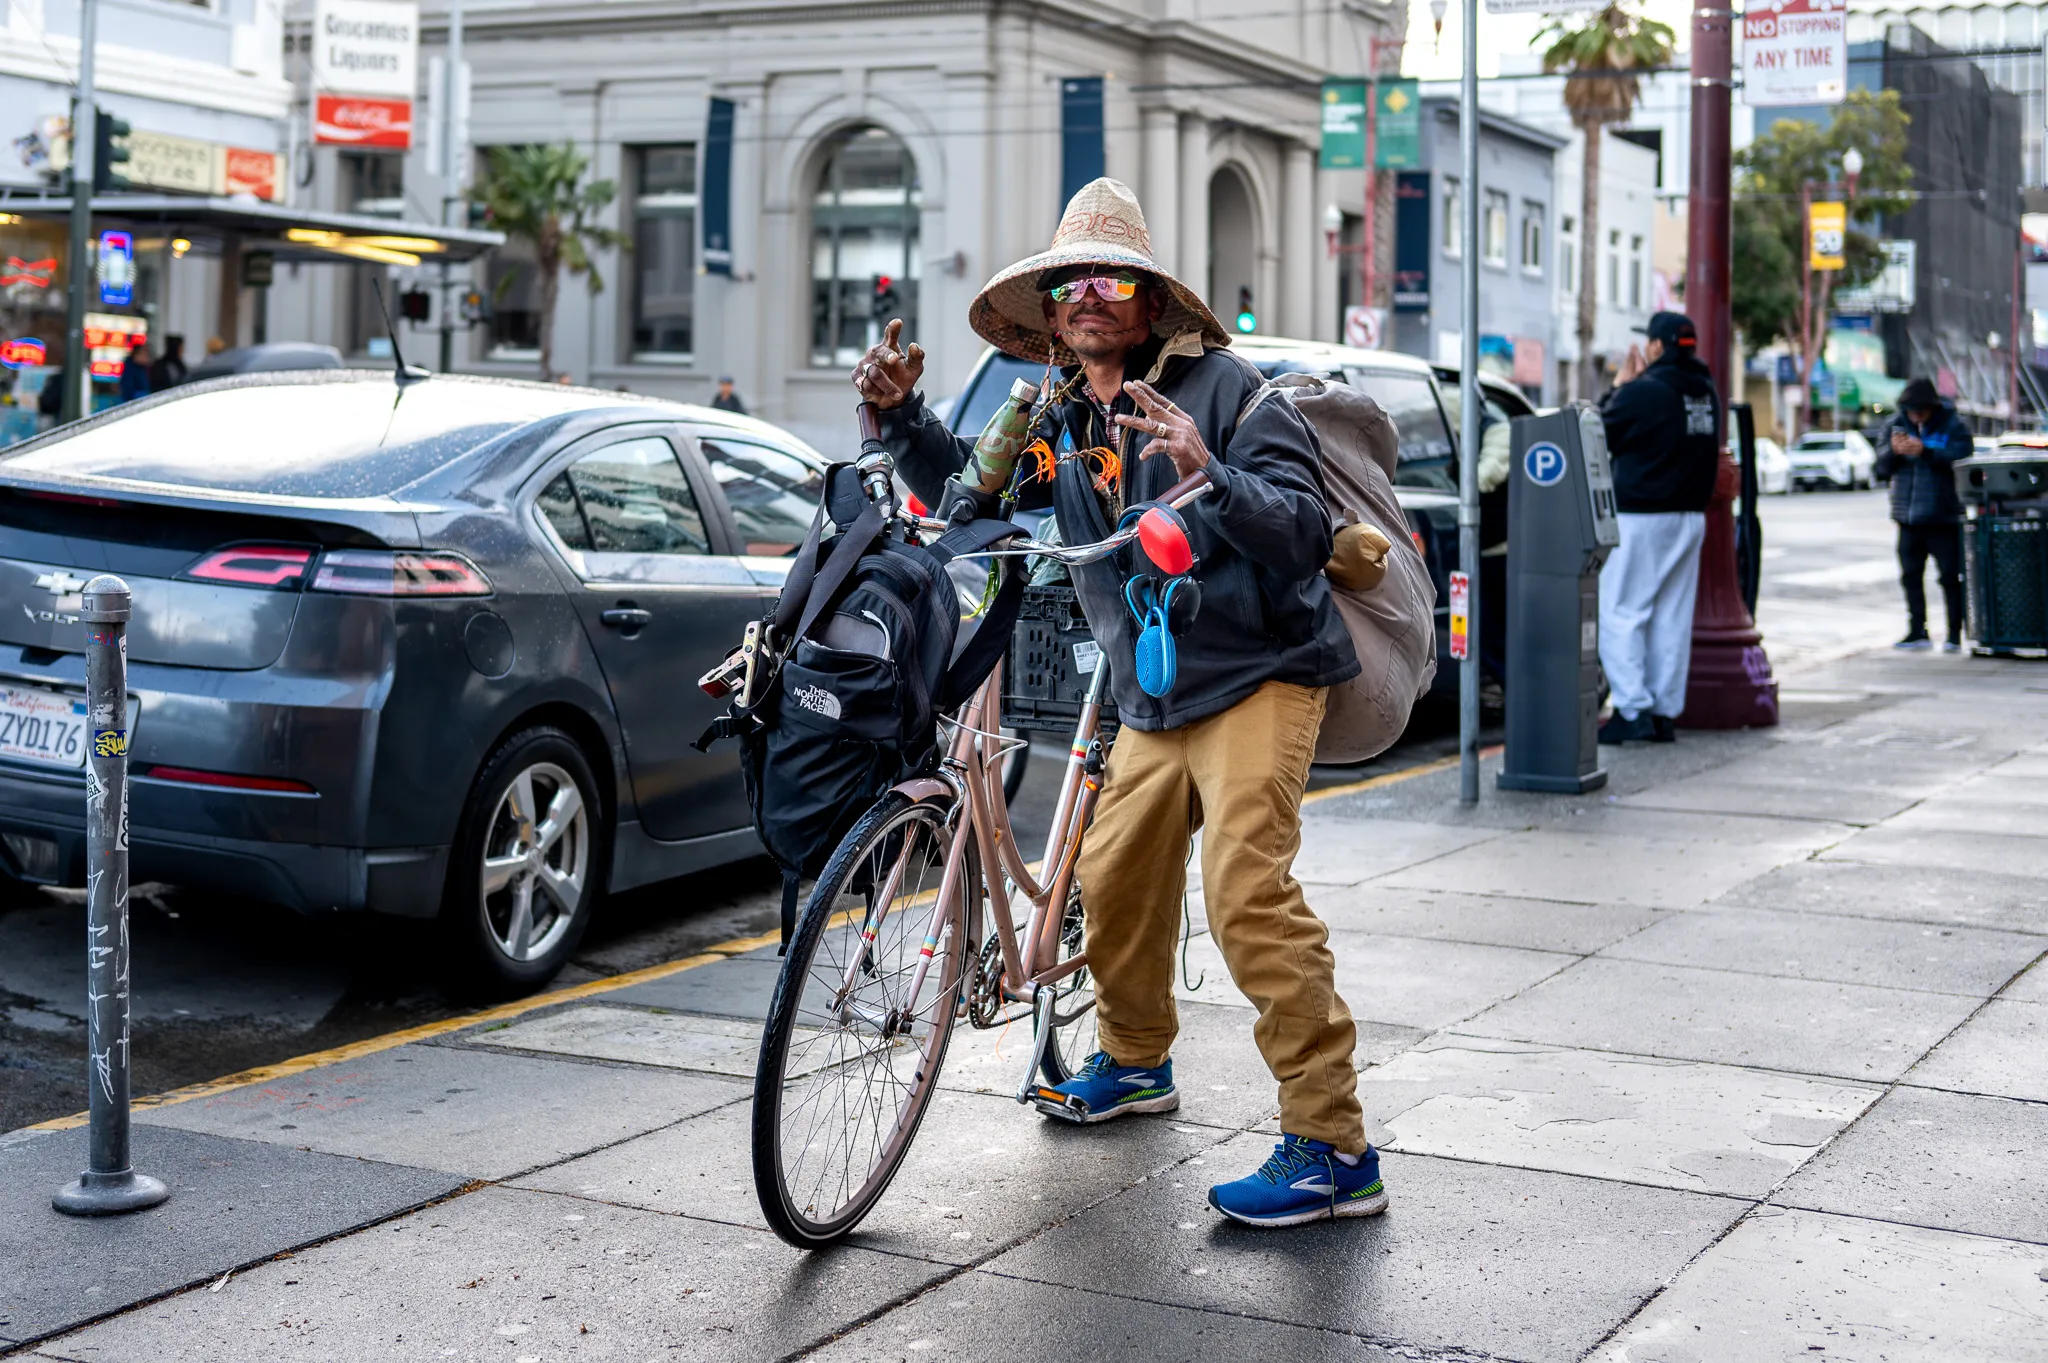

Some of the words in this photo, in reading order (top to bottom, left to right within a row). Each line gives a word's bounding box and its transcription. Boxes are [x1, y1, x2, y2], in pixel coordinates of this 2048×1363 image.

[1746, 18, 1776, 37] NO
[1780, 17, 1841, 35] STOPPING
[1754, 48, 1787, 69] ANY
[1793, 46, 1834, 67] TIME
[1536, 450, 1556, 479] P
[23, 604, 79, 624] VOLT
[793, 687, 826, 706] NORTH
[809, 684, 828, 698] THE
[799, 698, 825, 714] FACE
[0, 711, 82, 755] ZYD176
